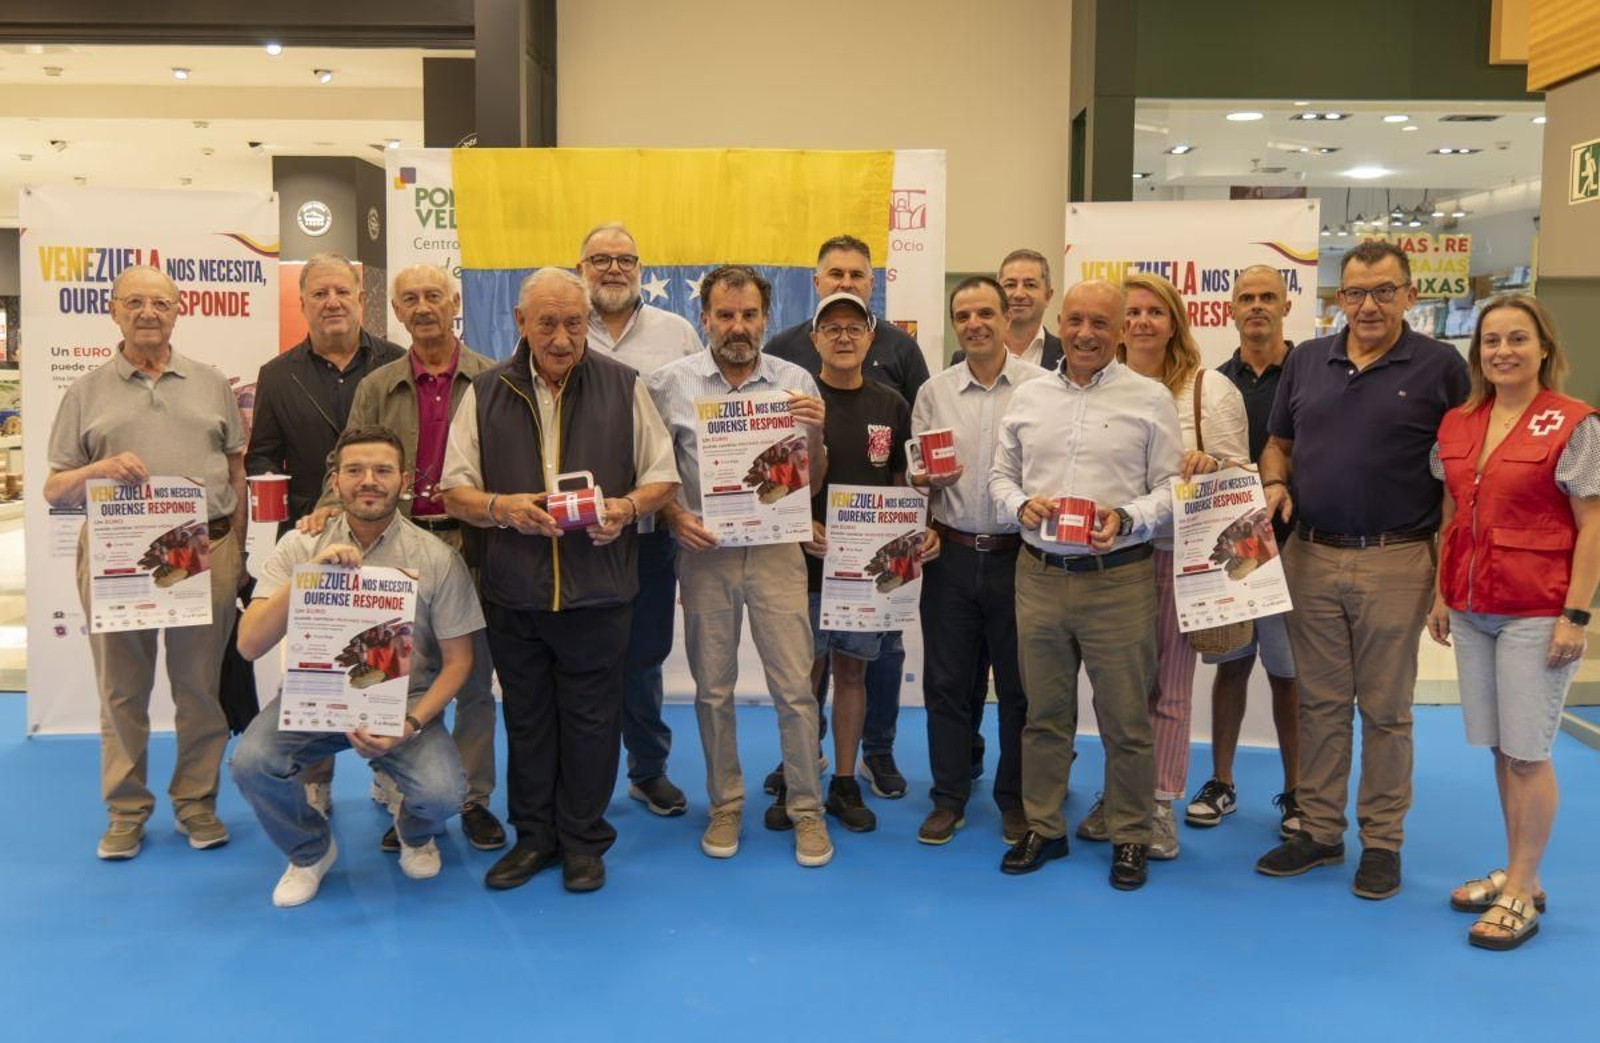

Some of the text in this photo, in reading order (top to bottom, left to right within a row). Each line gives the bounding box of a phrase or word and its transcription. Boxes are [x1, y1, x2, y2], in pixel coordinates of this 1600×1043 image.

[413, 236, 461, 250] Centro
[892, 239, 924, 251] Ocio
[1445, 238, 1469, 253] RE
[166, 258, 196, 282] NOS
[199, 259, 267, 287] NECESITA,
[1201, 269, 1230, 292] NOS
[1416, 278, 1466, 294] IXAS
[59, 287, 250, 318] OURE SPONDE
[51, 346, 112, 357] Un EURO
[51, 362, 86, 372] puede
[698, 400, 791, 421] VENEZUELA NOS NECES
[708, 416, 796, 434] OURENSE RESPONDE
[90, 484, 152, 502] VENEZUELA
[154, 487, 169, 499] NOS
[831, 491, 884, 510] VENEZUELA
[1213, 491, 1254, 508] RESPONDE
[101, 502, 197, 517] OURENSE RESPONDE
[838, 510, 918, 524] OURENSE RESPONDE
[296, 571, 360, 592] VENEZUELA
[362, 579, 377, 592] NOS
[304, 591, 405, 610] OURENSE RESPONDE
